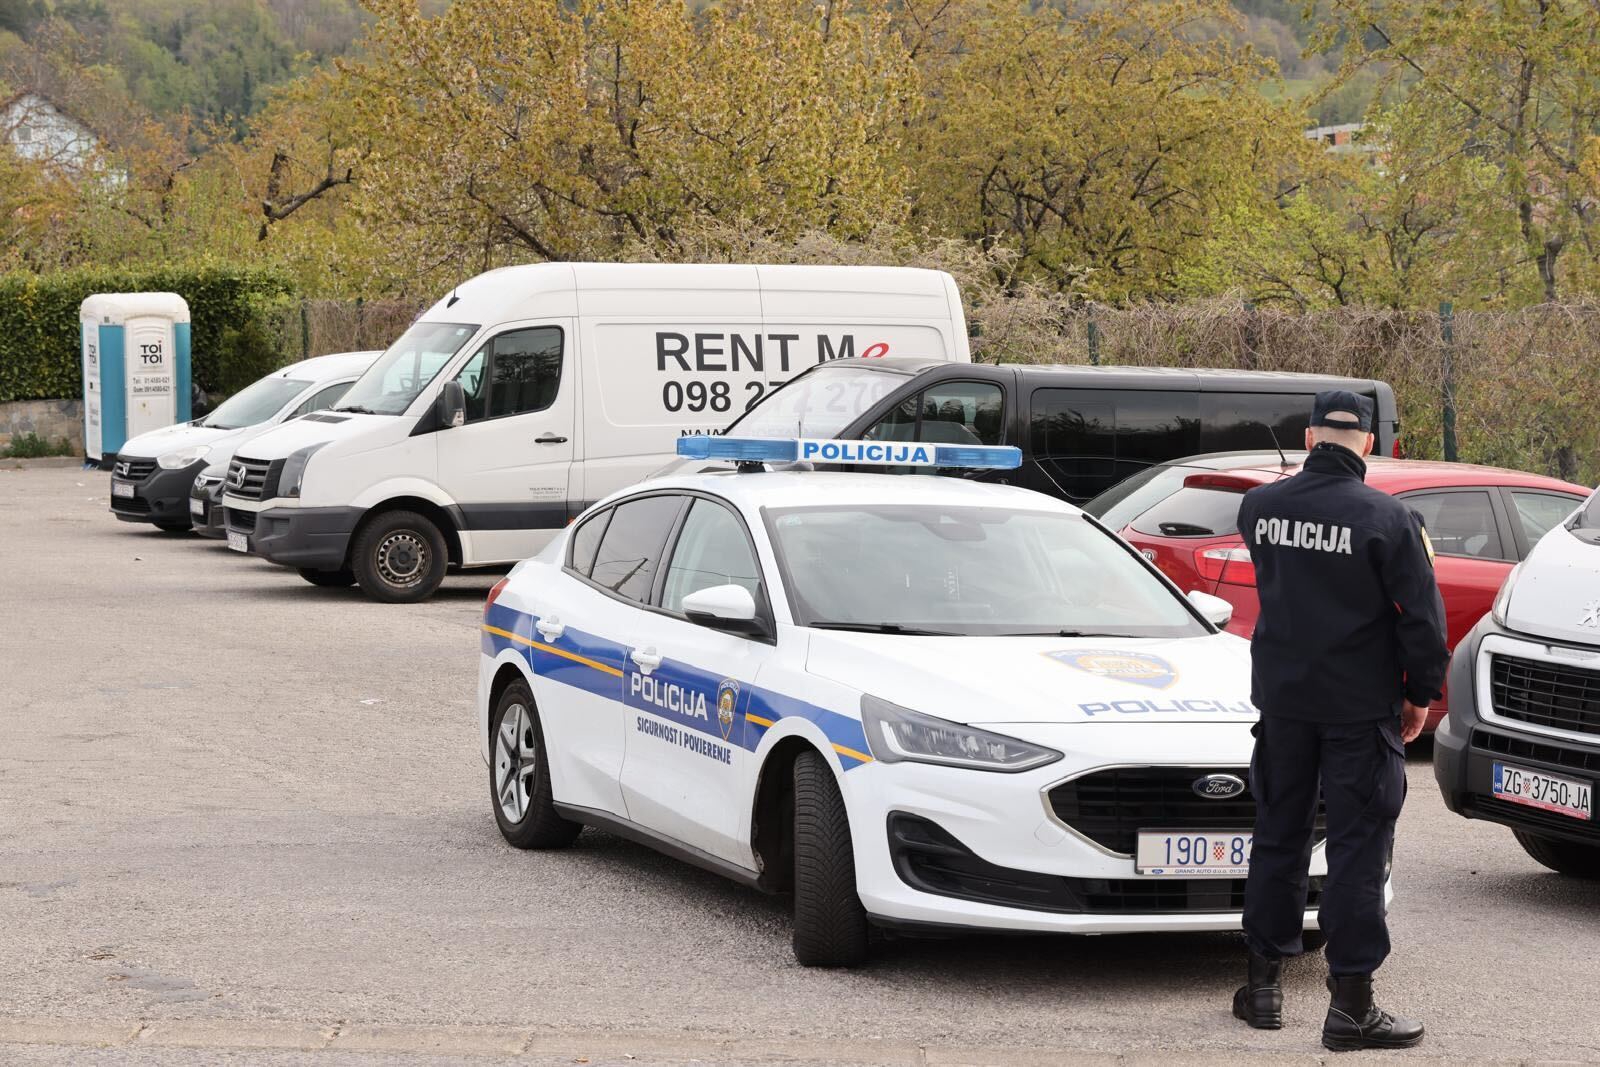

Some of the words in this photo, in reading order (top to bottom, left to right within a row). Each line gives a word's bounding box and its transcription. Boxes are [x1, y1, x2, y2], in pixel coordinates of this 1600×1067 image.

[140, 354, 162, 364] TOI
[655, 332, 799, 372] RENT
[662, 380, 732, 413] 098
[803, 442, 929, 463] POLICIJA
[1255, 517, 1353, 555] POLICIJA
[631, 671, 709, 721] POLICIJA
[1078, 699, 1261, 717] POLICIJ
[636, 716, 678, 746] SIGURNOST
[679, 731, 683, 747] I
[683, 732, 732, 765] POVJERENJE
[1205, 779, 1234, 794] Ford
[1504, 769, 1522, 795] ZG
[1165, 837, 1207, 865] 190
